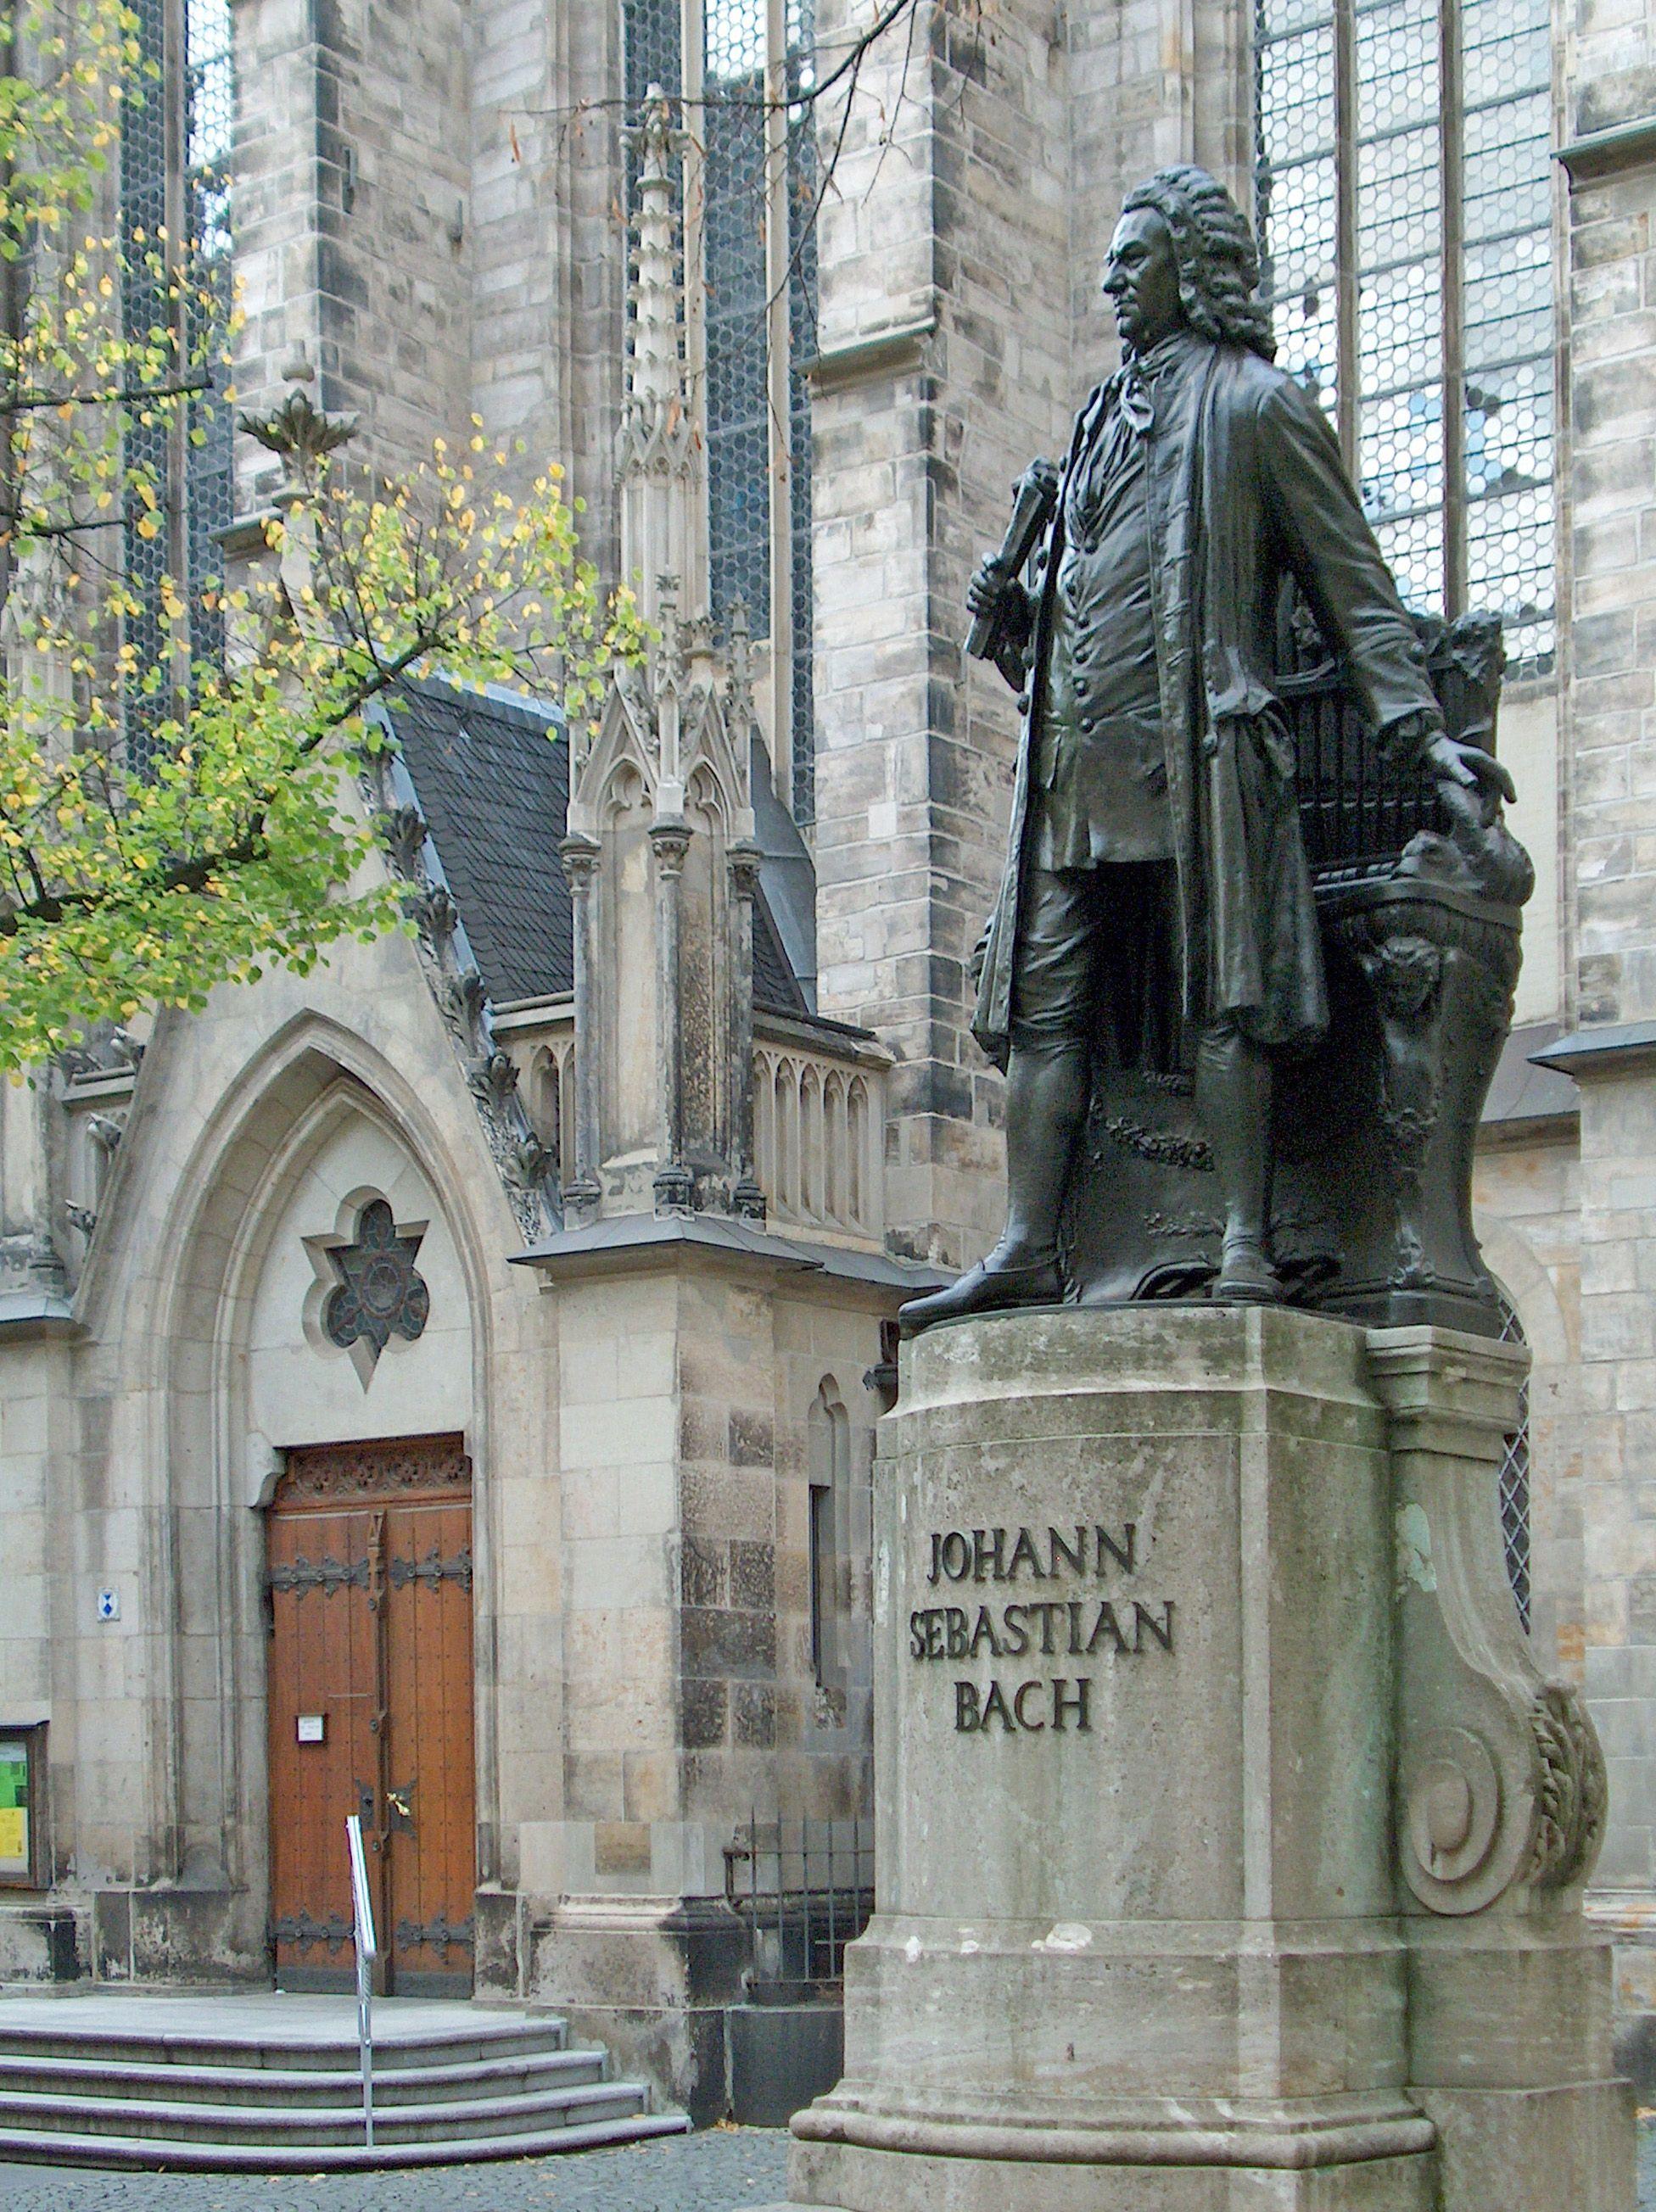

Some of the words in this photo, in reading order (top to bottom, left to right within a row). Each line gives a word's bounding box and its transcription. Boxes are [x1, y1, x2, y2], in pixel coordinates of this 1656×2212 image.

[926, 1523, 1137, 1584] JOHANN
[909, 1600, 1175, 1660] SEBASTIAN
[954, 1678, 1093, 1731] BACH
